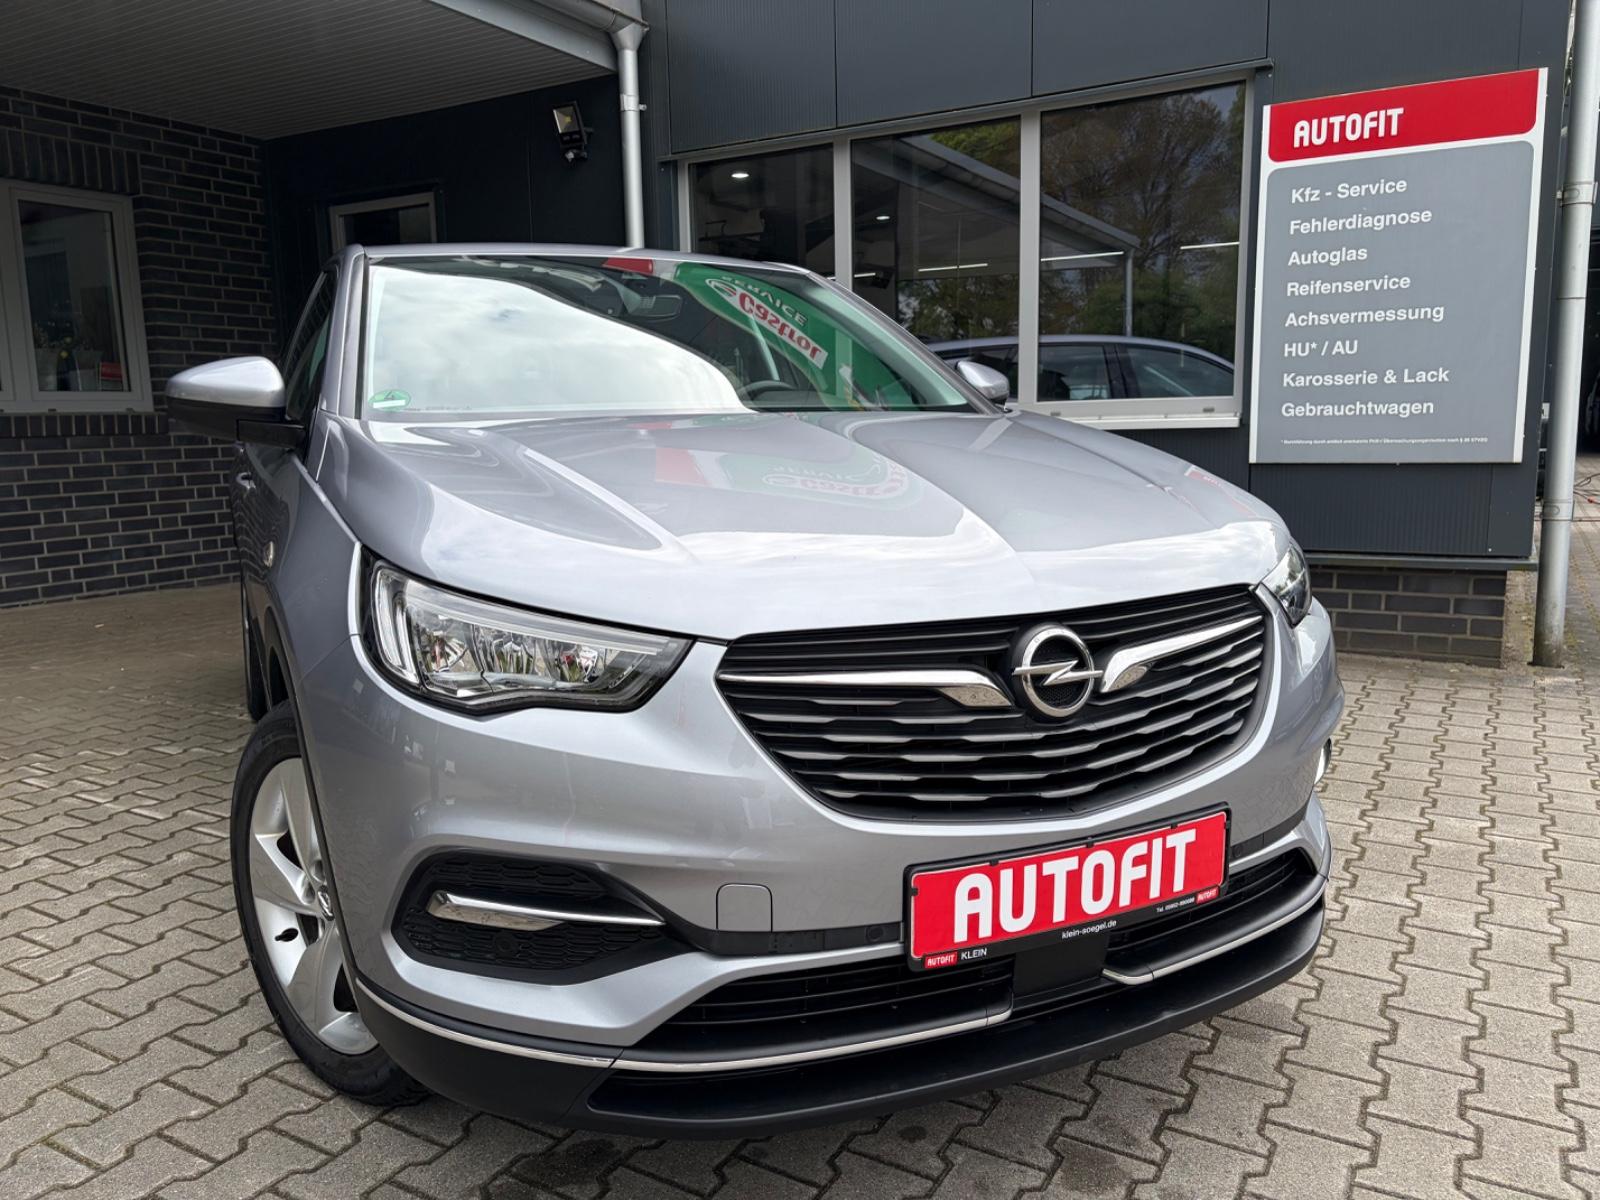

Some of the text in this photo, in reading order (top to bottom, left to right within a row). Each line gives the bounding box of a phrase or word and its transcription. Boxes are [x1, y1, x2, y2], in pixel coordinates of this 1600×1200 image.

[1293, 107, 1404, 148] AUTOFIT
[1291, 186, 1320, 203] Kfz
[1337, 178, 1407, 199] Service
[1289, 208, 1432, 235] Fehlerdiagnose
[1287, 246, 1367, 266] Autoglas
[1286, 274, 1411, 297] Reifenservice
[1284, 306, 1445, 328] Achsvermessung
[1320, 340, 1328, 356] /
[1331, 339, 1358, 356] AU
[1283, 367, 1449, 387] Karosserie & Lack
[1281, 400, 1434, 418] Gebrauchtwagen
[954, 828, 1196, 943] AUTOFIT
[1061, 919, 1117, 939] klein-soegel.de
[927, 948, 988, 967] AUTOFIT KLEIN
